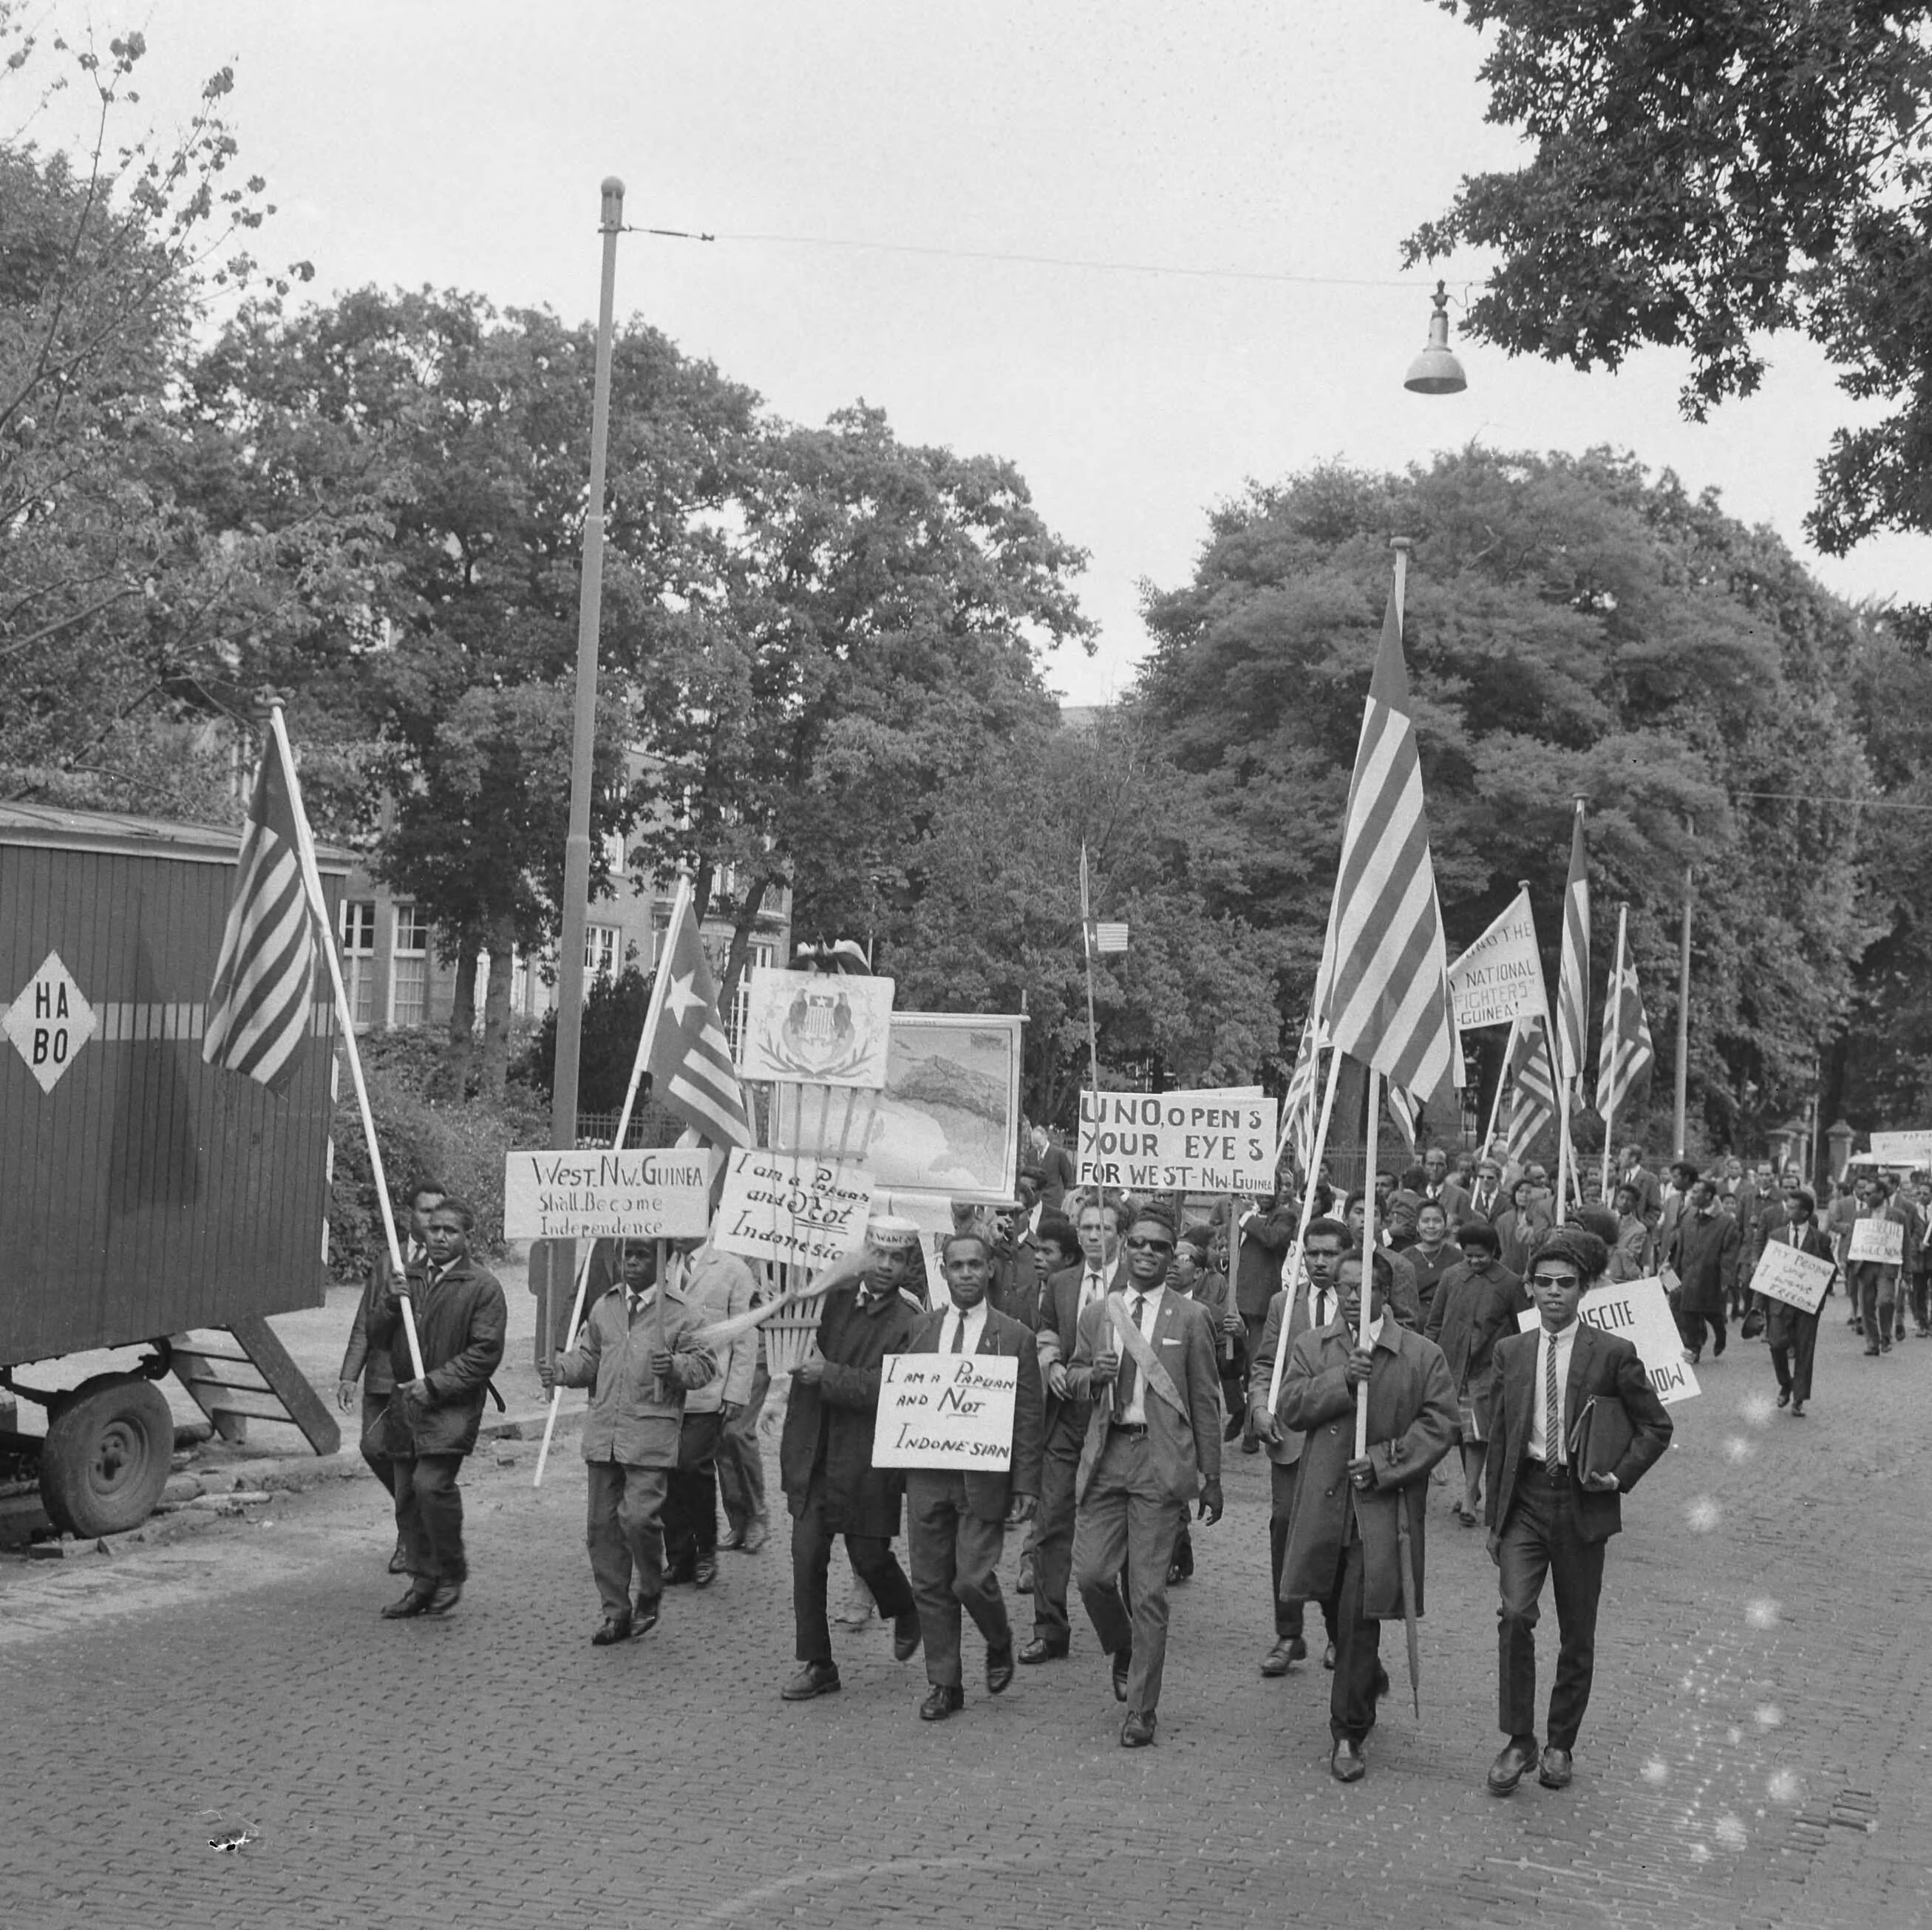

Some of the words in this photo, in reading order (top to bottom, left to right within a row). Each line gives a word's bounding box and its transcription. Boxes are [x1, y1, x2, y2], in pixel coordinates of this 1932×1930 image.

[1466, 959, 1535, 988] NATIONAL
[35, 982, 69, 1019] HA
[33, 1028, 68, 1064] BO
[1081, 1130, 1158, 1158] YOUR
[1185, 1135, 1263, 1161] EYES
[734, 1152, 752, 1175] I
[752, 1166, 783, 1182] am
[788, 1175, 800, 1187] a
[1081, 1162, 1120, 1184] FOR
[746, 1189, 786, 1207] and
[787, 1190, 854, 1224] Not
[540, 1215, 662, 1238] Independence
[884, 1357, 900, 1383] I
[904, 1373, 925, 1384] AM
[896, 1395, 928, 1406] AND
